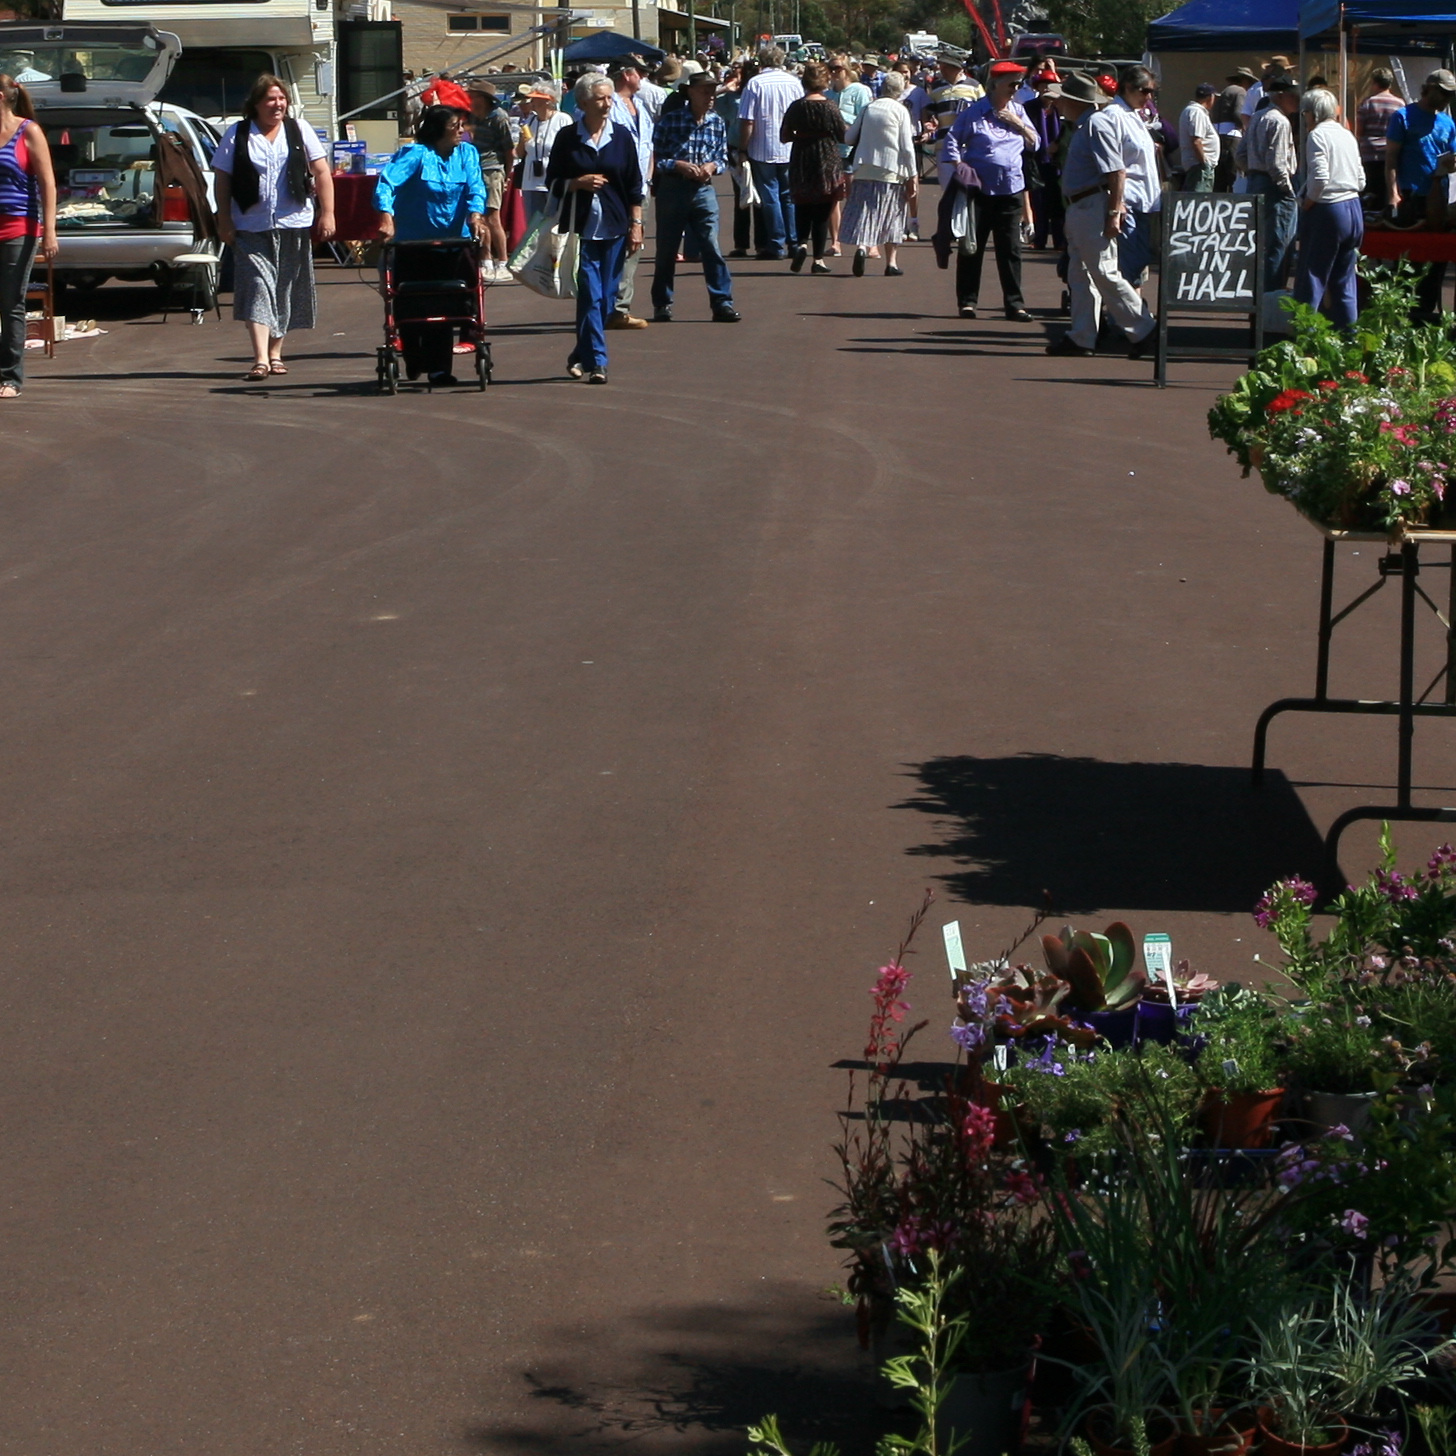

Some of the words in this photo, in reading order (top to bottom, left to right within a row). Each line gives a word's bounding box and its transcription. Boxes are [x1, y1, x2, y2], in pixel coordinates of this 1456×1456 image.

[1172, 199, 1253, 233] MORE
[1169, 229, 1256, 256] STALLS
[1199, 252, 1230, 273] IN
[1176, 269, 1253, 301] HALL
